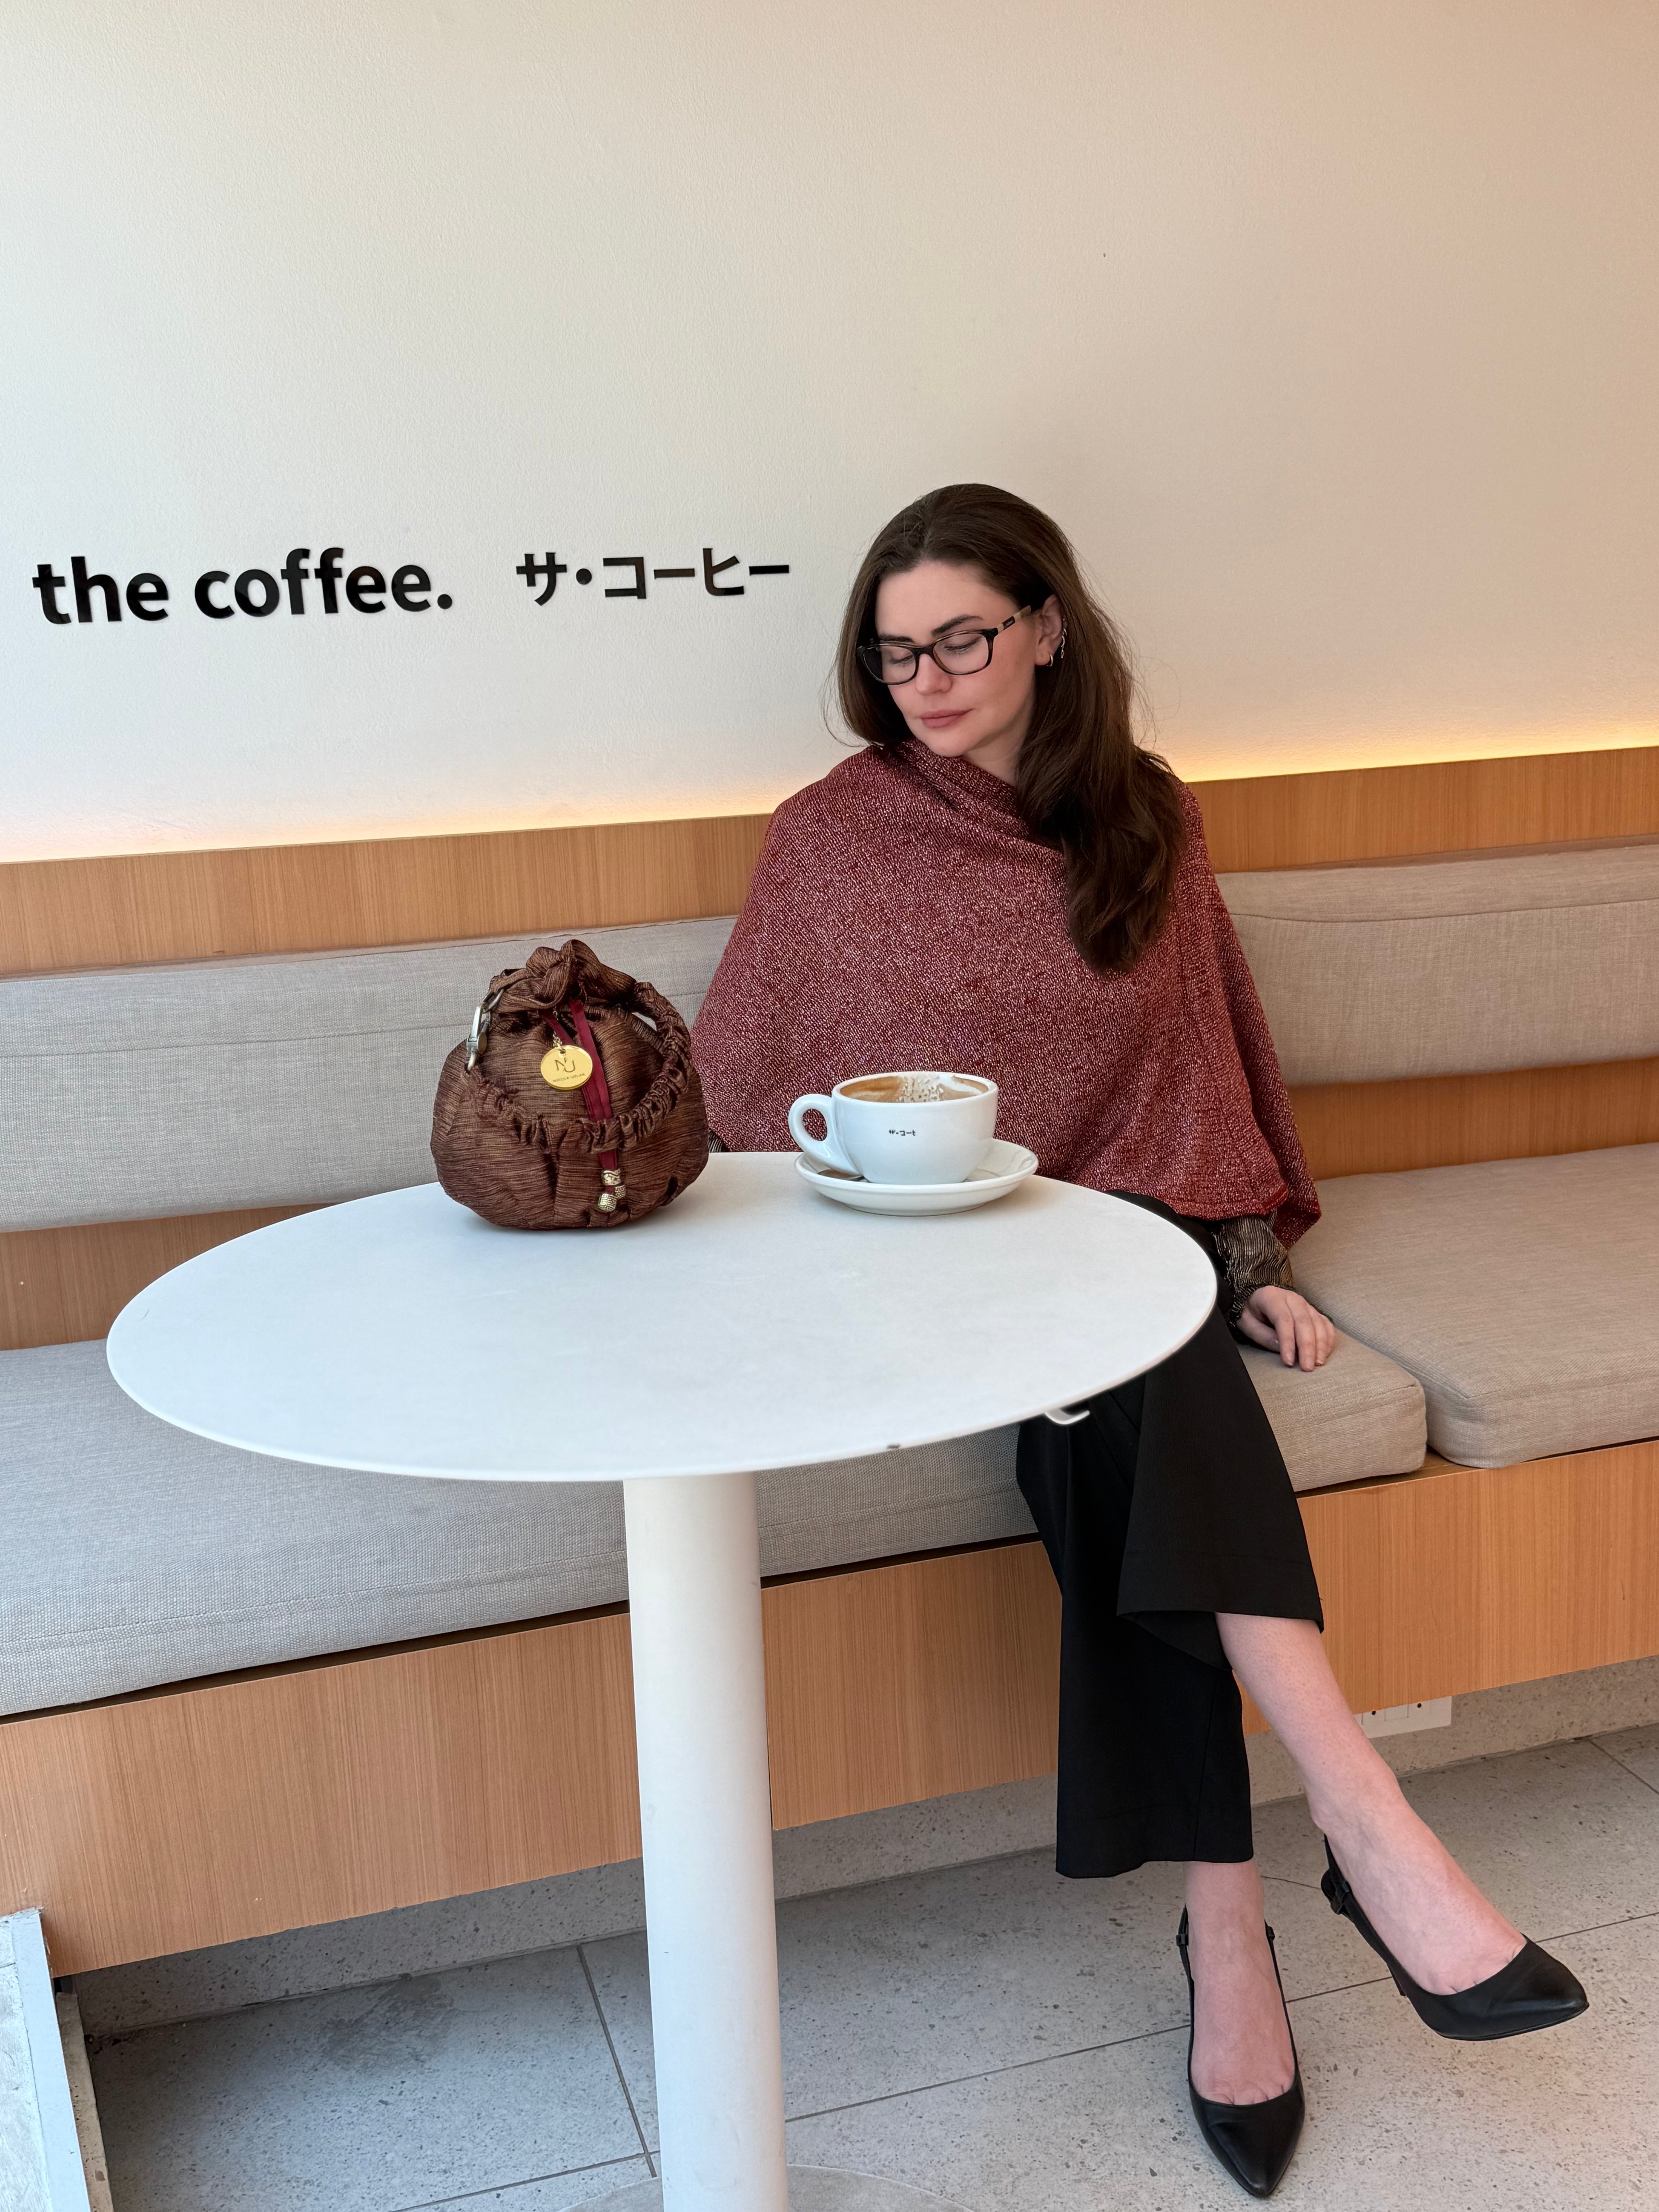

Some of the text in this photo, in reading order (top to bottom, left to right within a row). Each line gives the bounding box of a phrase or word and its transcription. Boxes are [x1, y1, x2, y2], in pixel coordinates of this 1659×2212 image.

[32, 547, 453, 625] the coffee.
[516, 548, 790, 606] サ・コーヒー
